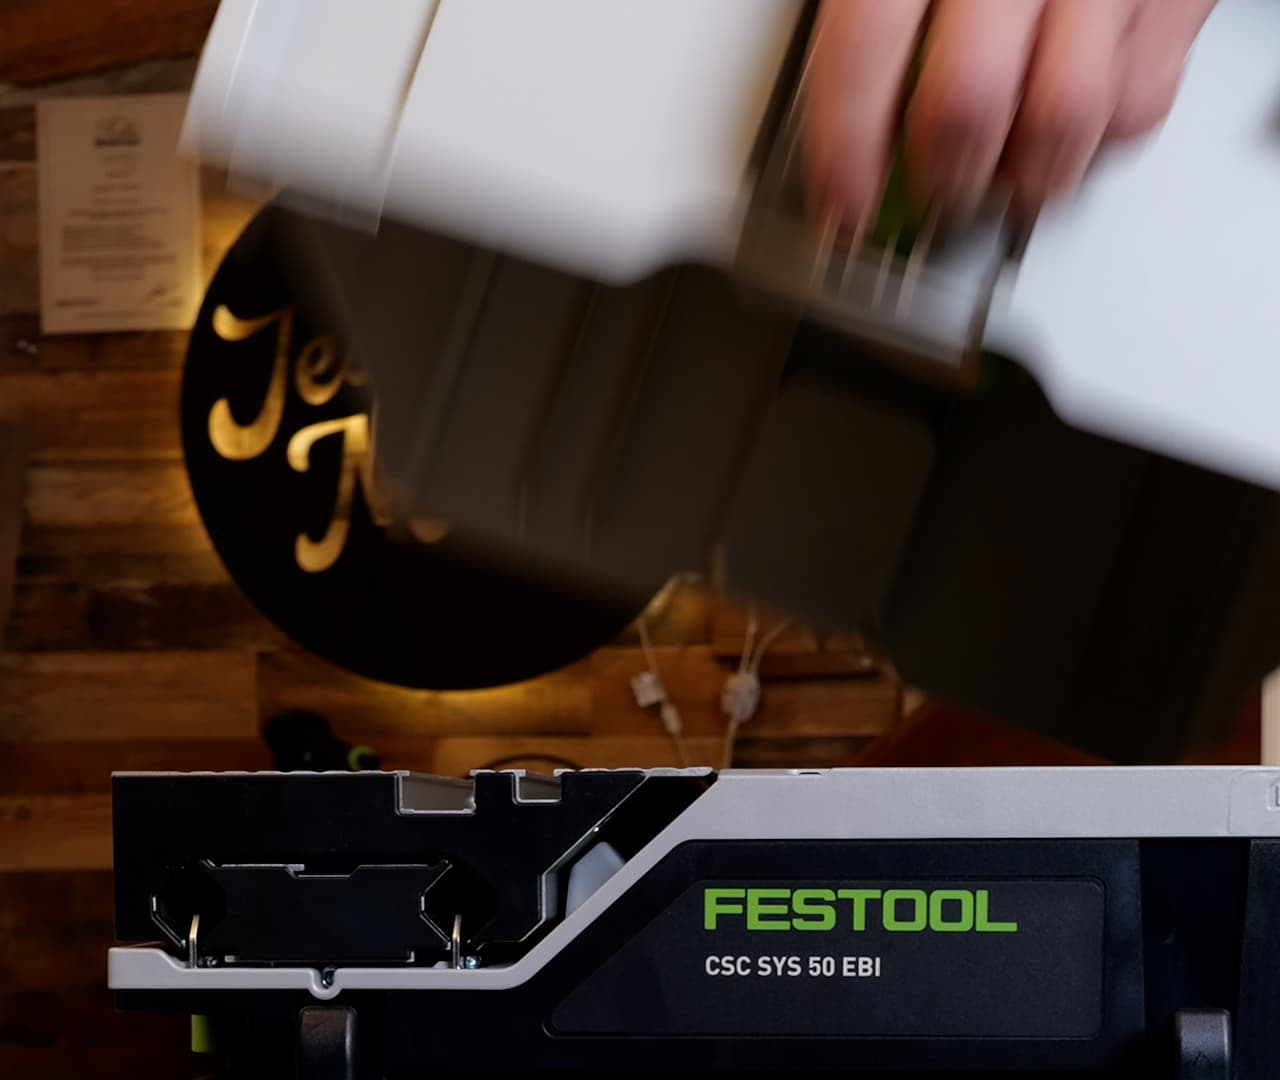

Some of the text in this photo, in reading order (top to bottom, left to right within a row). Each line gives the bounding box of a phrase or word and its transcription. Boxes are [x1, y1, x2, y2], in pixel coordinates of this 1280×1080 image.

[704, 888, 1018, 932] FESTOOL
[704, 956, 881, 977] CSC SYS 50 EBI
